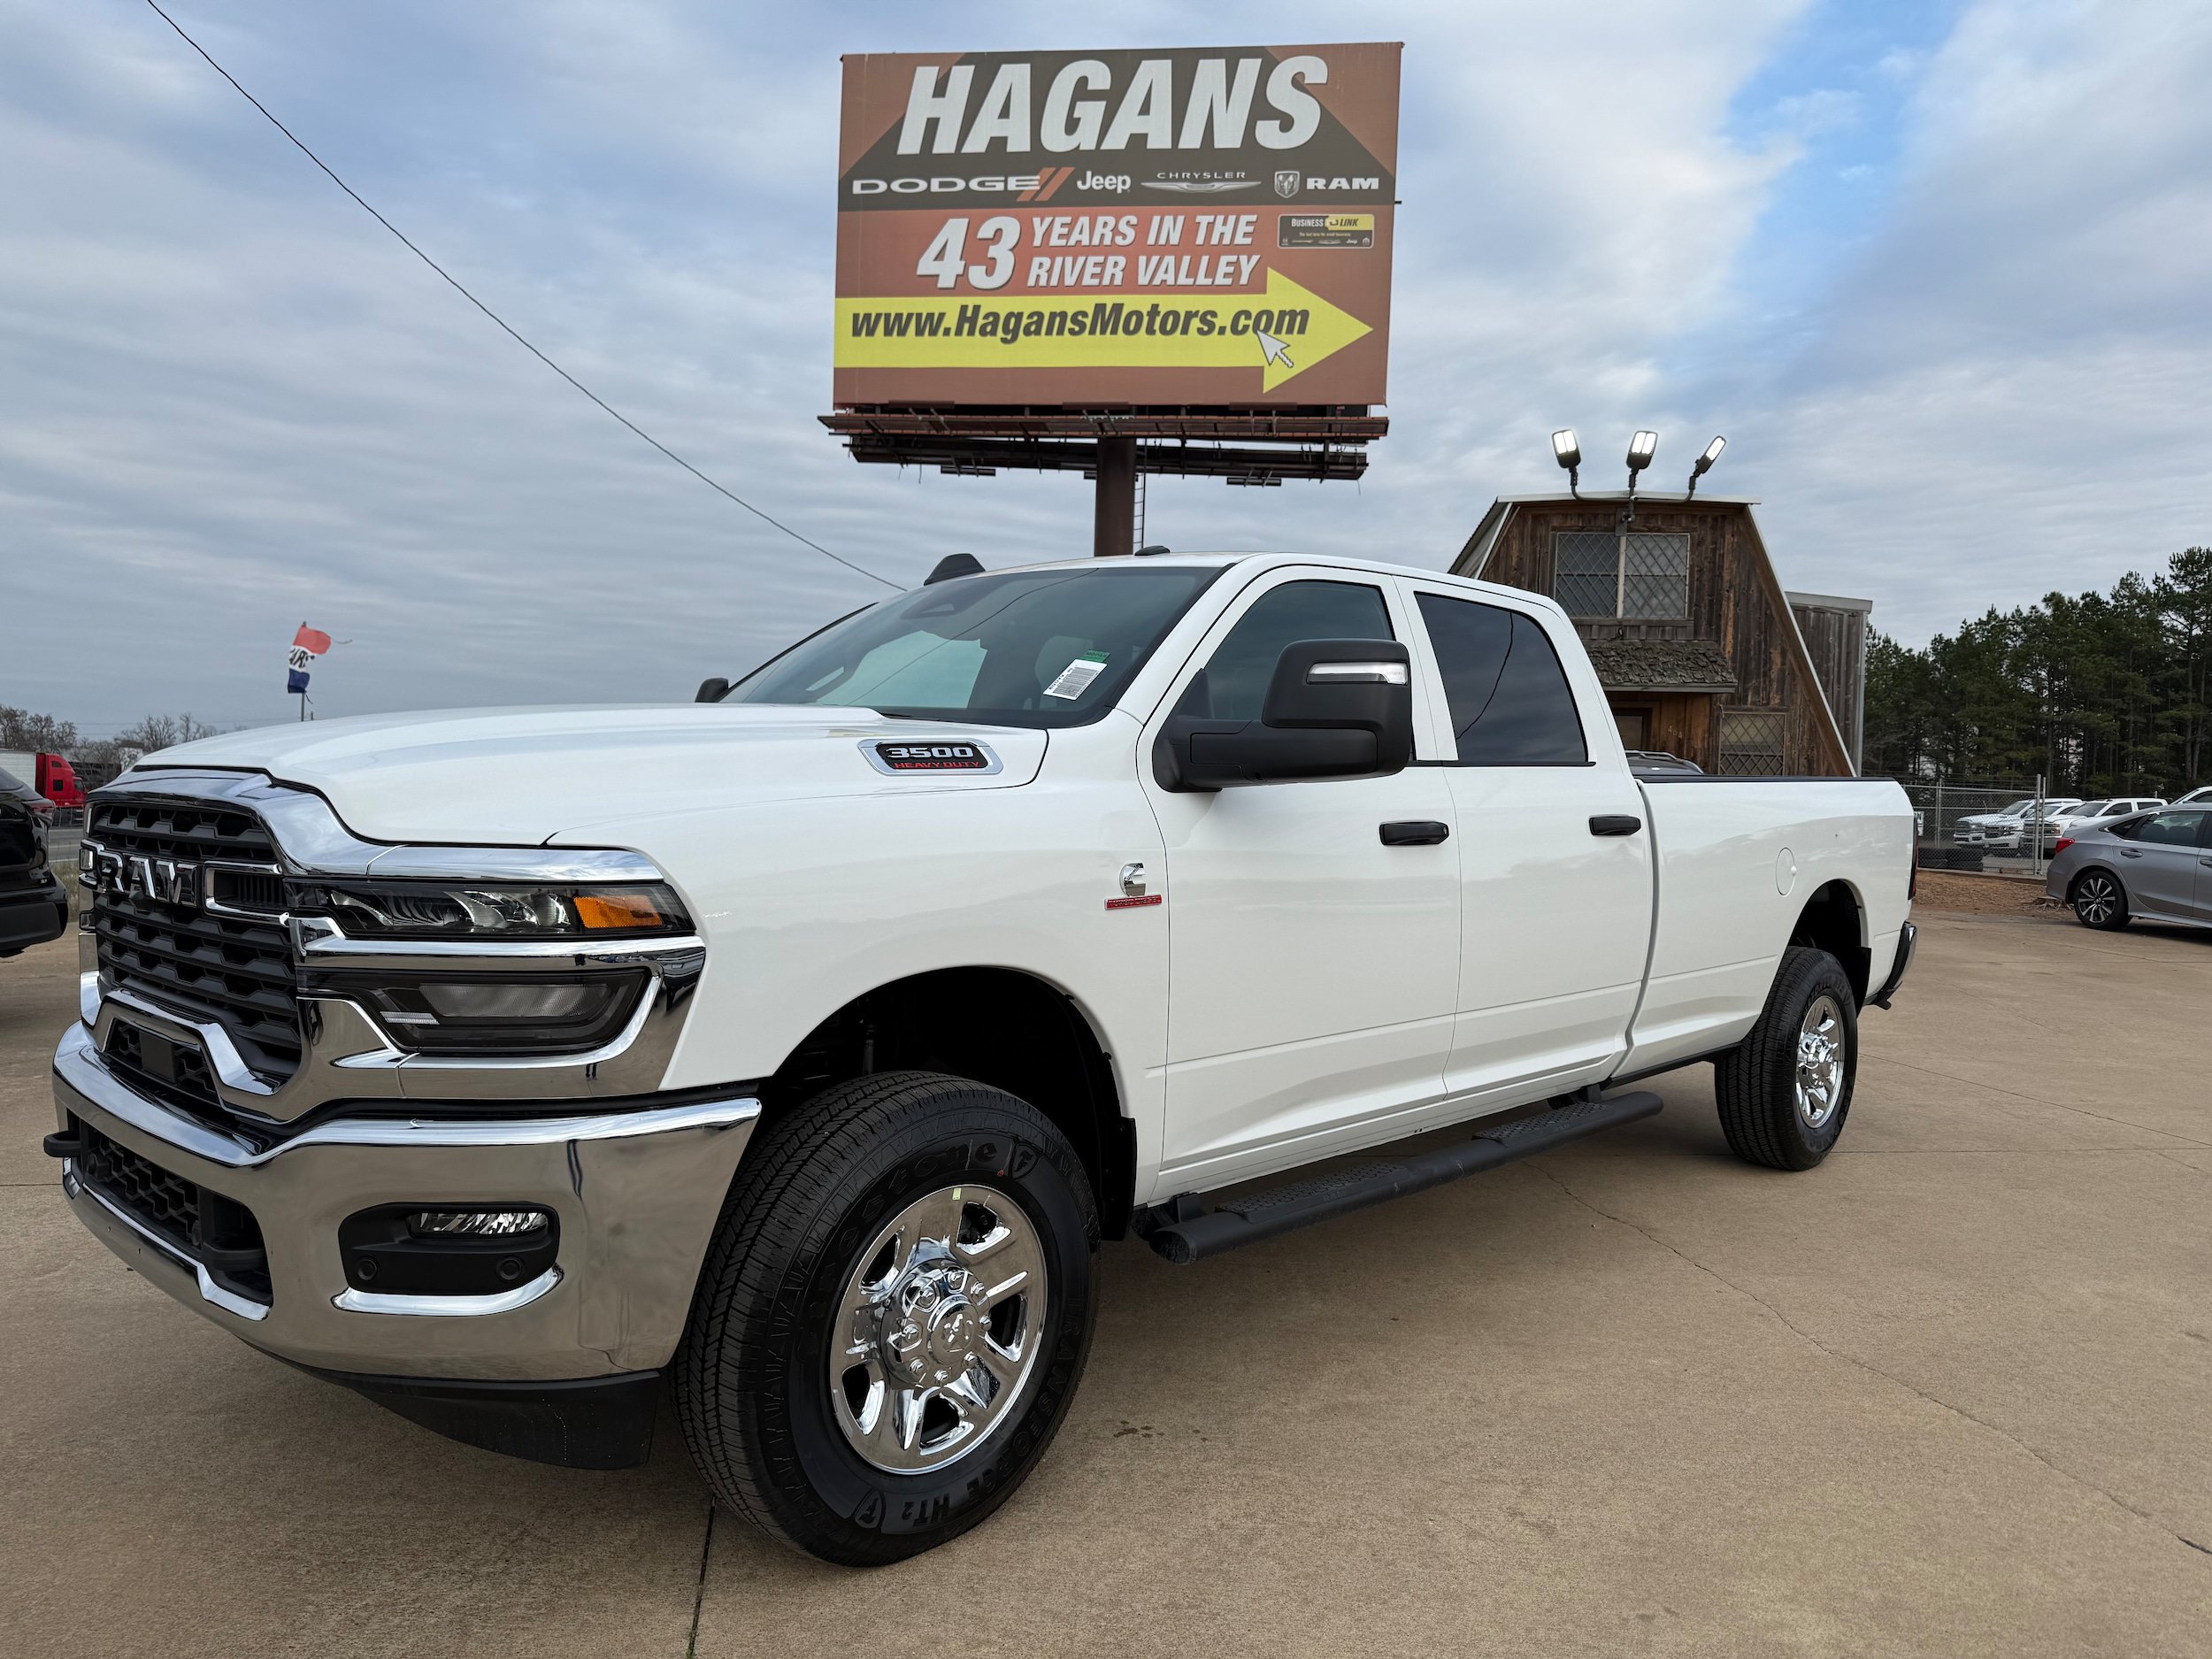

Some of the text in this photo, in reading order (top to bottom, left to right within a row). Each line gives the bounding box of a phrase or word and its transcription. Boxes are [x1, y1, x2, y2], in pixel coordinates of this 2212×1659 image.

[896, 55, 1328, 156] HAGANS
[852, 175, 1041, 195] DODGE
[1076, 170, 1131, 194] Jeep
[1156, 171, 1247, 180] CHRYSLER
[1306, 177, 1379, 190] RAM
[1032, 214, 1257, 248] YEARS IN THE
[1291, 218, 1359, 227] BUSINESS LINK
[916, 214, 1022, 291] 43
[1027, 254, 1261, 288] RIVER VALLEY
[851, 302, 1310, 345] www.HagansMotors.com
[885, 747, 974, 758] 3500
[96, 849, 198, 907] RAM
[965, 1296, 1085, 1499] TRANSFORCE
[901, 1492, 951, 1528] HT2
